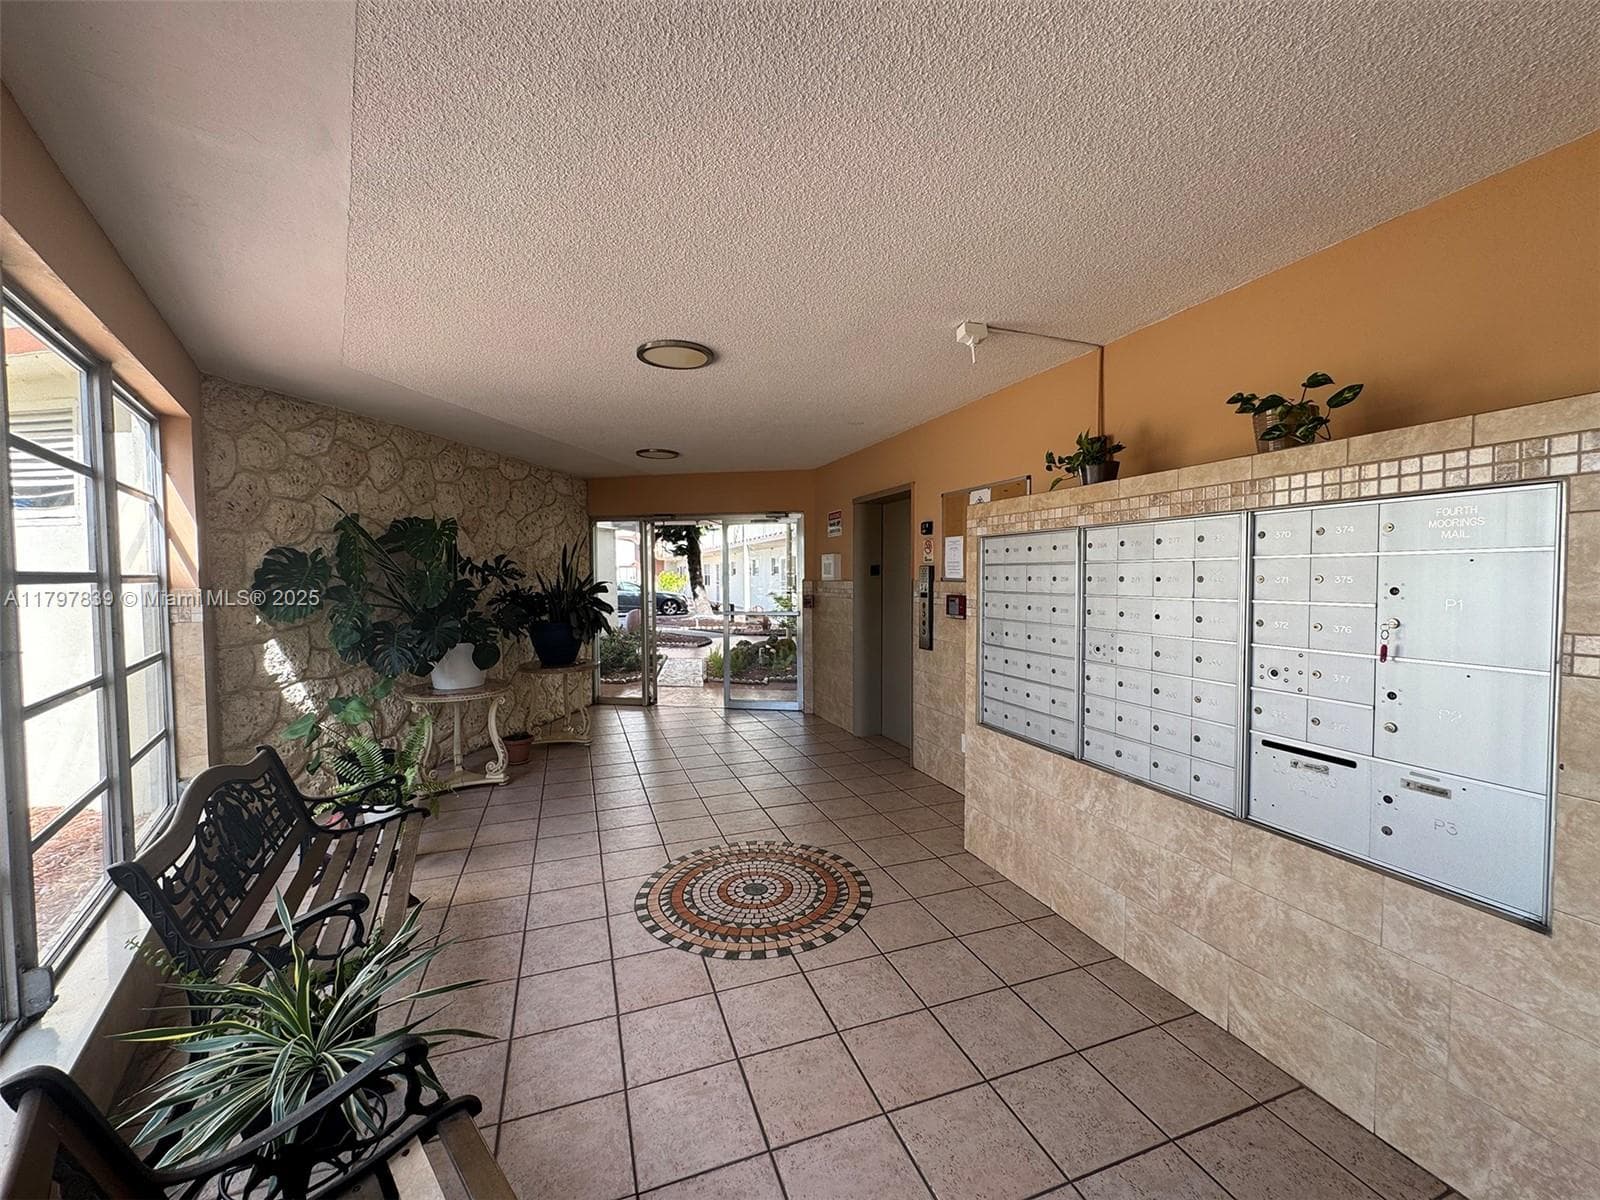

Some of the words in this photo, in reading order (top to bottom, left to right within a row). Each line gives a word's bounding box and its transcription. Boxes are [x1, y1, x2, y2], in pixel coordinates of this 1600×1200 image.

[1436, 506, 1477, 516] FOURTH
[1428, 517, 1485, 529] MOORINGS
[1335, 525, 1354, 534] 374
[1440, 529, 1470, 539] MAIL
[1274, 575, 1289, 585] 371
[1334, 575, 1353, 584] 375
[1445, 598, 1463, 611] P1
[1274, 620, 1289, 630] 372
[1333, 625, 1352, 634] 376
[1434, 818, 1459, 836] P3
